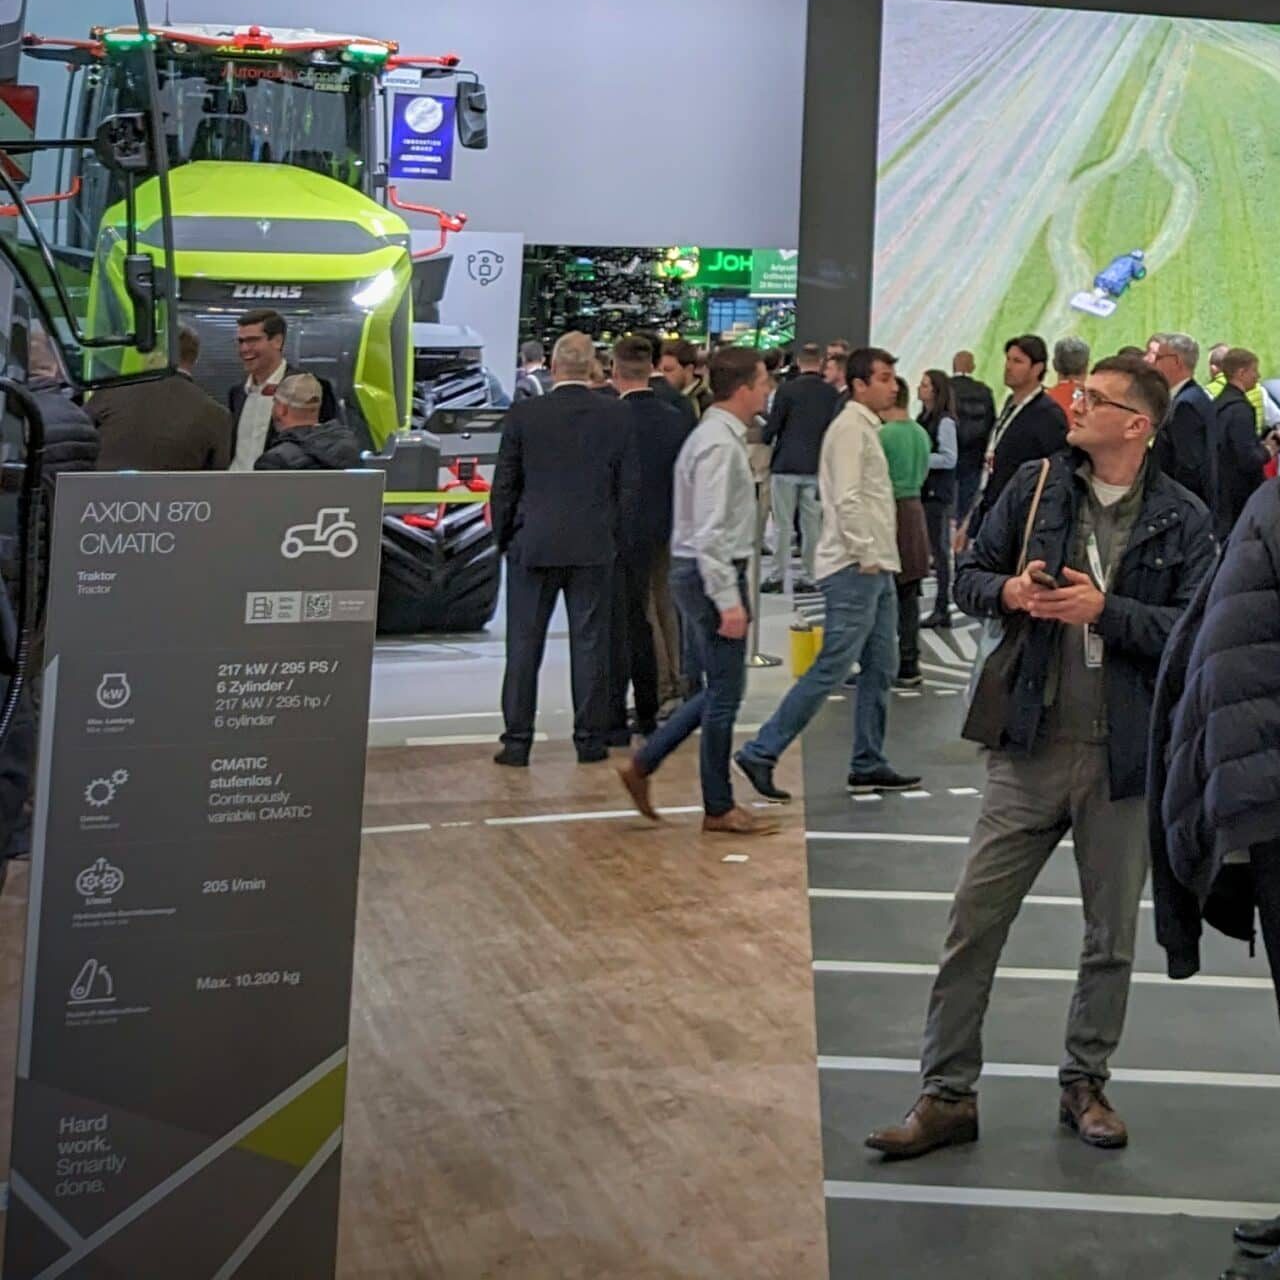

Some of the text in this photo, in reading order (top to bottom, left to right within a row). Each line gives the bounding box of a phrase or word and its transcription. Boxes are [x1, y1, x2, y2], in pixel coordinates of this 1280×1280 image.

[233, 283, 303, 299] CLAAS
[80, 501, 212, 523] AXION 870
[79, 532, 176, 555] CMATIC
[77, 571, 117, 581] Traktor
[77, 584, 112, 595] Tractor
[218, 663, 243, 677] 217
[245, 663, 269, 676] kW
[280, 662, 306, 674] 295
[308, 661, 329, 673] PS
[228, 679, 285, 695] Zylinder
[215, 697, 239, 711] 217
[241, 696, 266, 710] kW
[303, 695, 322, 709] hp
[226, 714, 277, 729] cylinder
[210, 756, 269, 772] CMATIC
[209, 774, 273, 789] stufenlos
[208, 791, 291, 807] Continuously
[258, 805, 313, 820] CMATIC
[59, 1113, 109, 1135] Hard
[56, 1153, 127, 1176] Smartly
